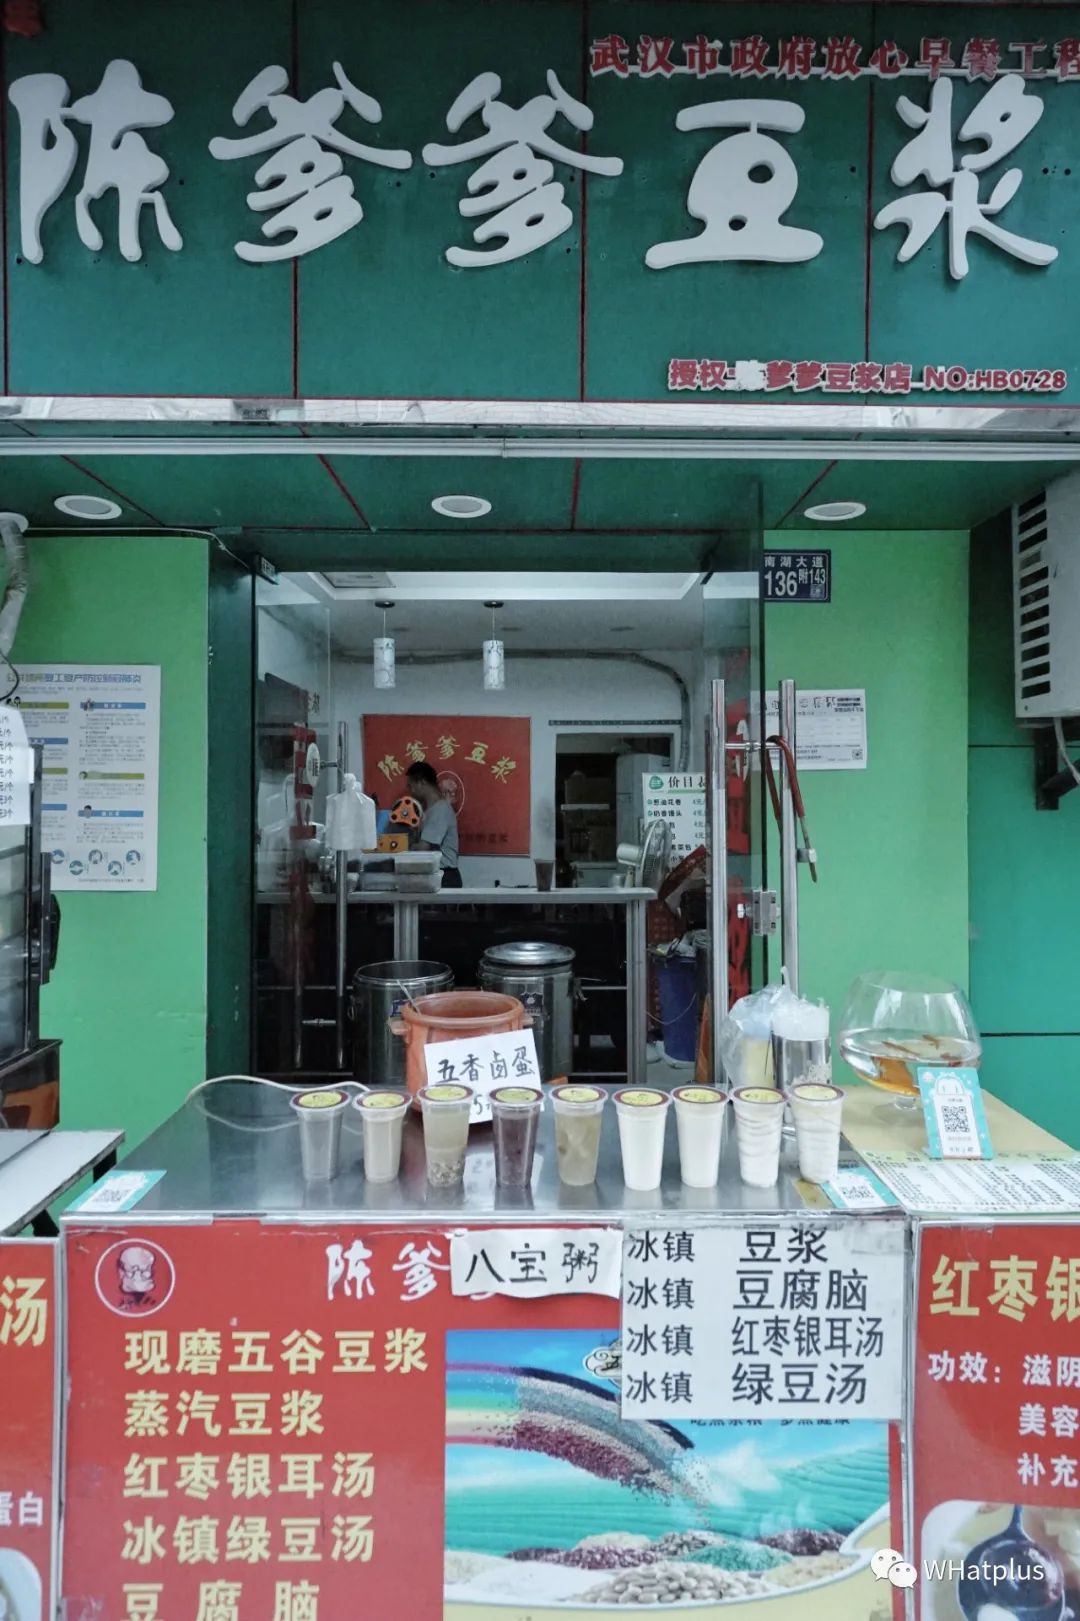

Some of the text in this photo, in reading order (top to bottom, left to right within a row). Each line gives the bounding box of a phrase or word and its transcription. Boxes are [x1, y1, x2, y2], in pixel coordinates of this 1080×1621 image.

[590, 34, 1080, 81] 武汉市政府放心早餐工程
[7, 57, 1060, 281] 陈爹爹豆浆
[922, 365, 1068, 395] NO:HB0728
[764, 555, 824, 568] 南湖大道
[377, 734, 518, 785] 陈爹爹豆浆
[435, 1045, 535, 1084] 五香卤蛋
[465, 1242, 600, 1284] 八宝粥
[627, 1222, 829, 1265] 冰镇 豆浆
[626, 1268, 869, 1312] 冰镇 豆腐脑
[930, 1253, 1080, 1323] 红枣银
[0, 1275, 48, 1348] 汤
[123, 1329, 429, 1375] 现磨五谷豆浆
[626, 1314, 885, 1359] 冰镇 红枣银耳汤
[625, 1361, 868, 1406] 冰镇 绿豆汤
[1022, 1354, 1080, 1387] 滋阴
[123, 1390, 325, 1438] 蒸汽豆浆
[1018, 1402, 1079, 1439] 美容
[122, 1451, 376, 1501] 红枣银耳汤
[1017, 1451, 1079, 1488] 补充
[121, 1514, 376, 1565] 冰镇绿豆汤
[121, 1578, 321, 1621] 豆腐脑
